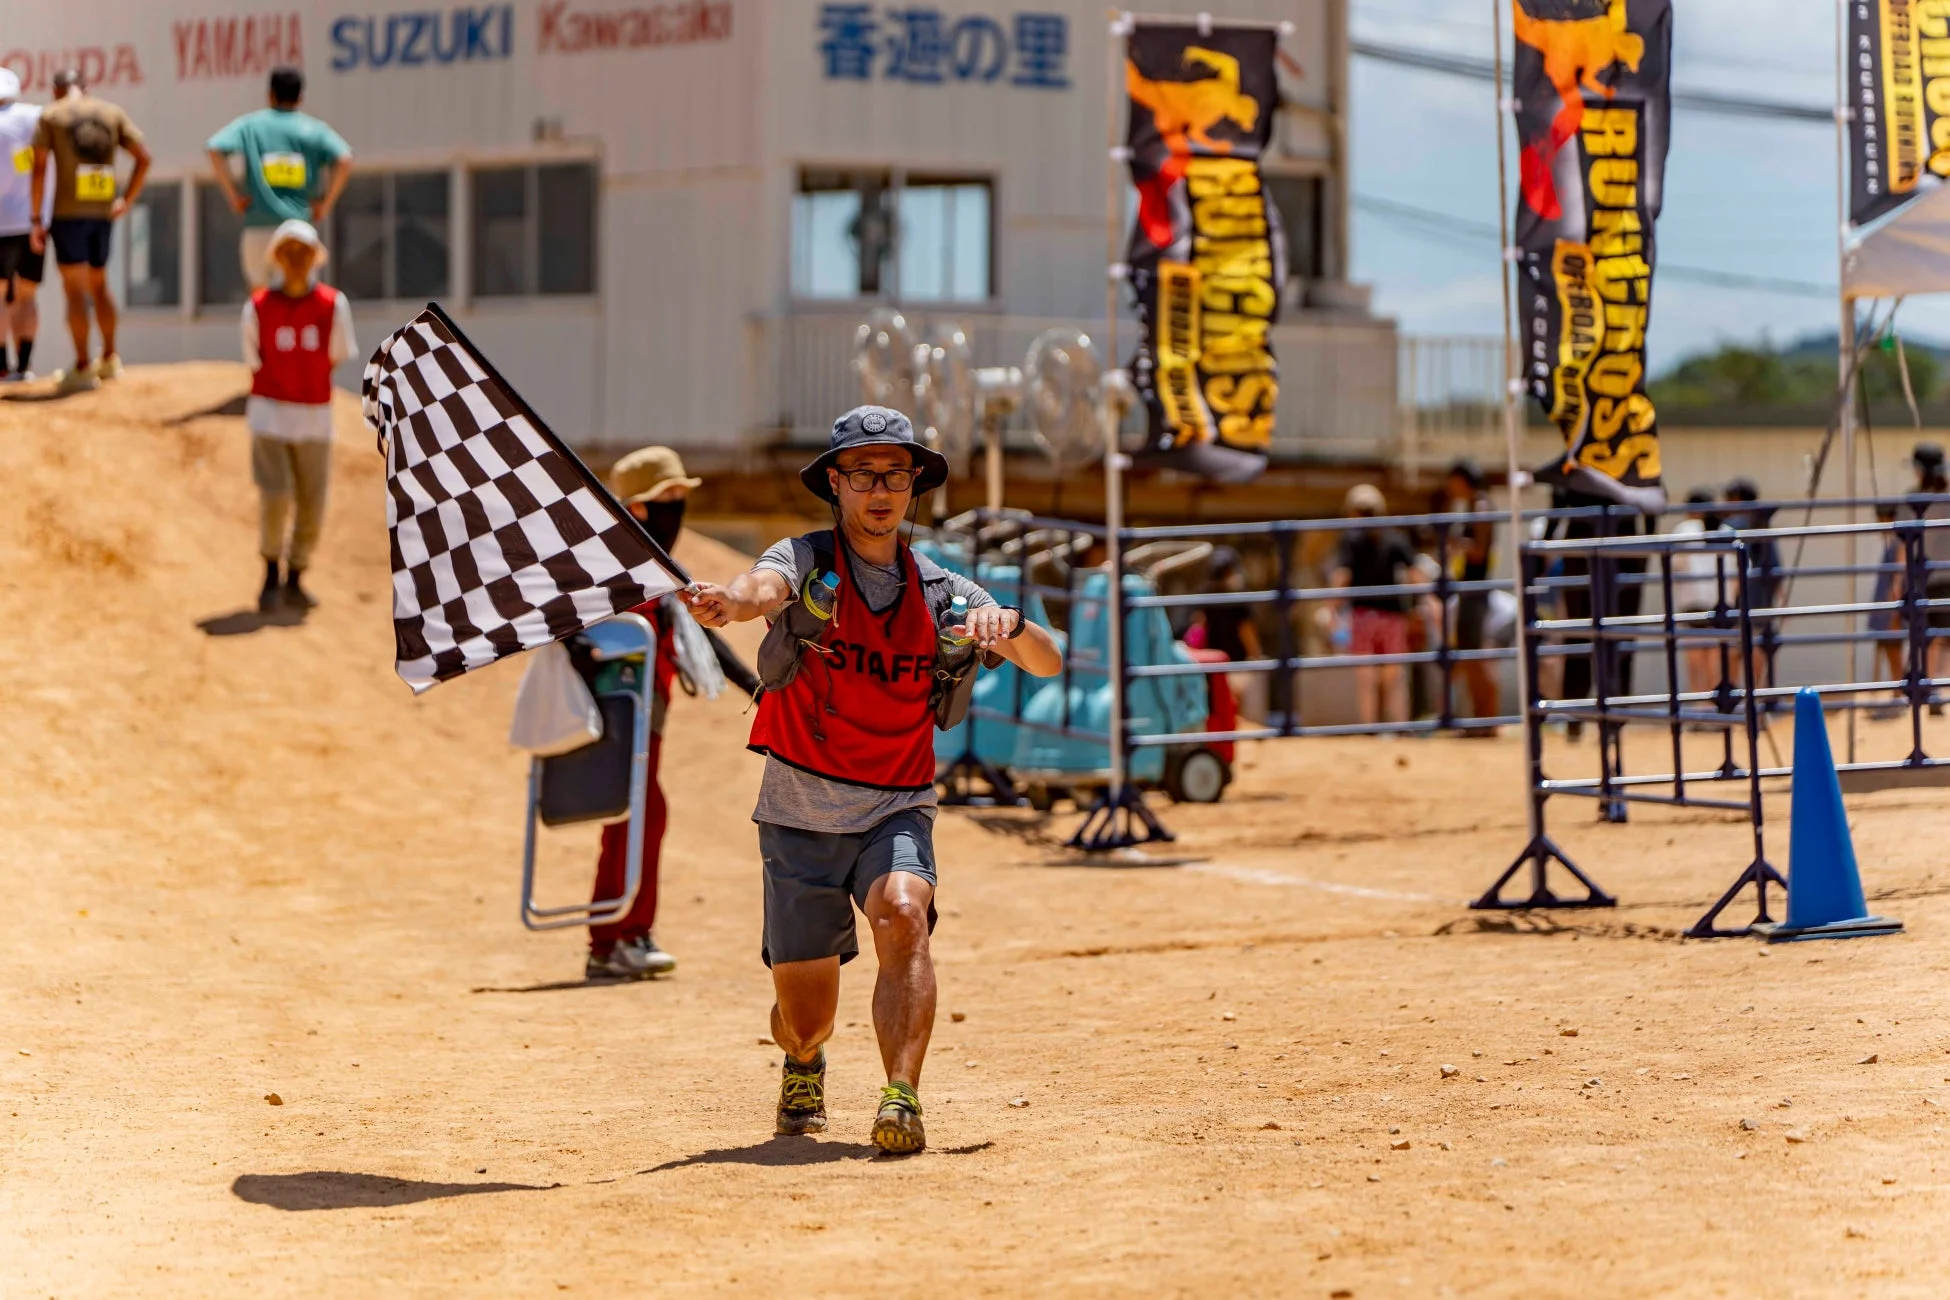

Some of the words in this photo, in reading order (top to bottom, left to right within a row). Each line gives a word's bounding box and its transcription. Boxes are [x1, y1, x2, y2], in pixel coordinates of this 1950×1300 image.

[172, 10, 305, 81] YAMAHA
[329, 4, 515, 72] SUZUKI
[825, 638, 931, 683] STAFF
